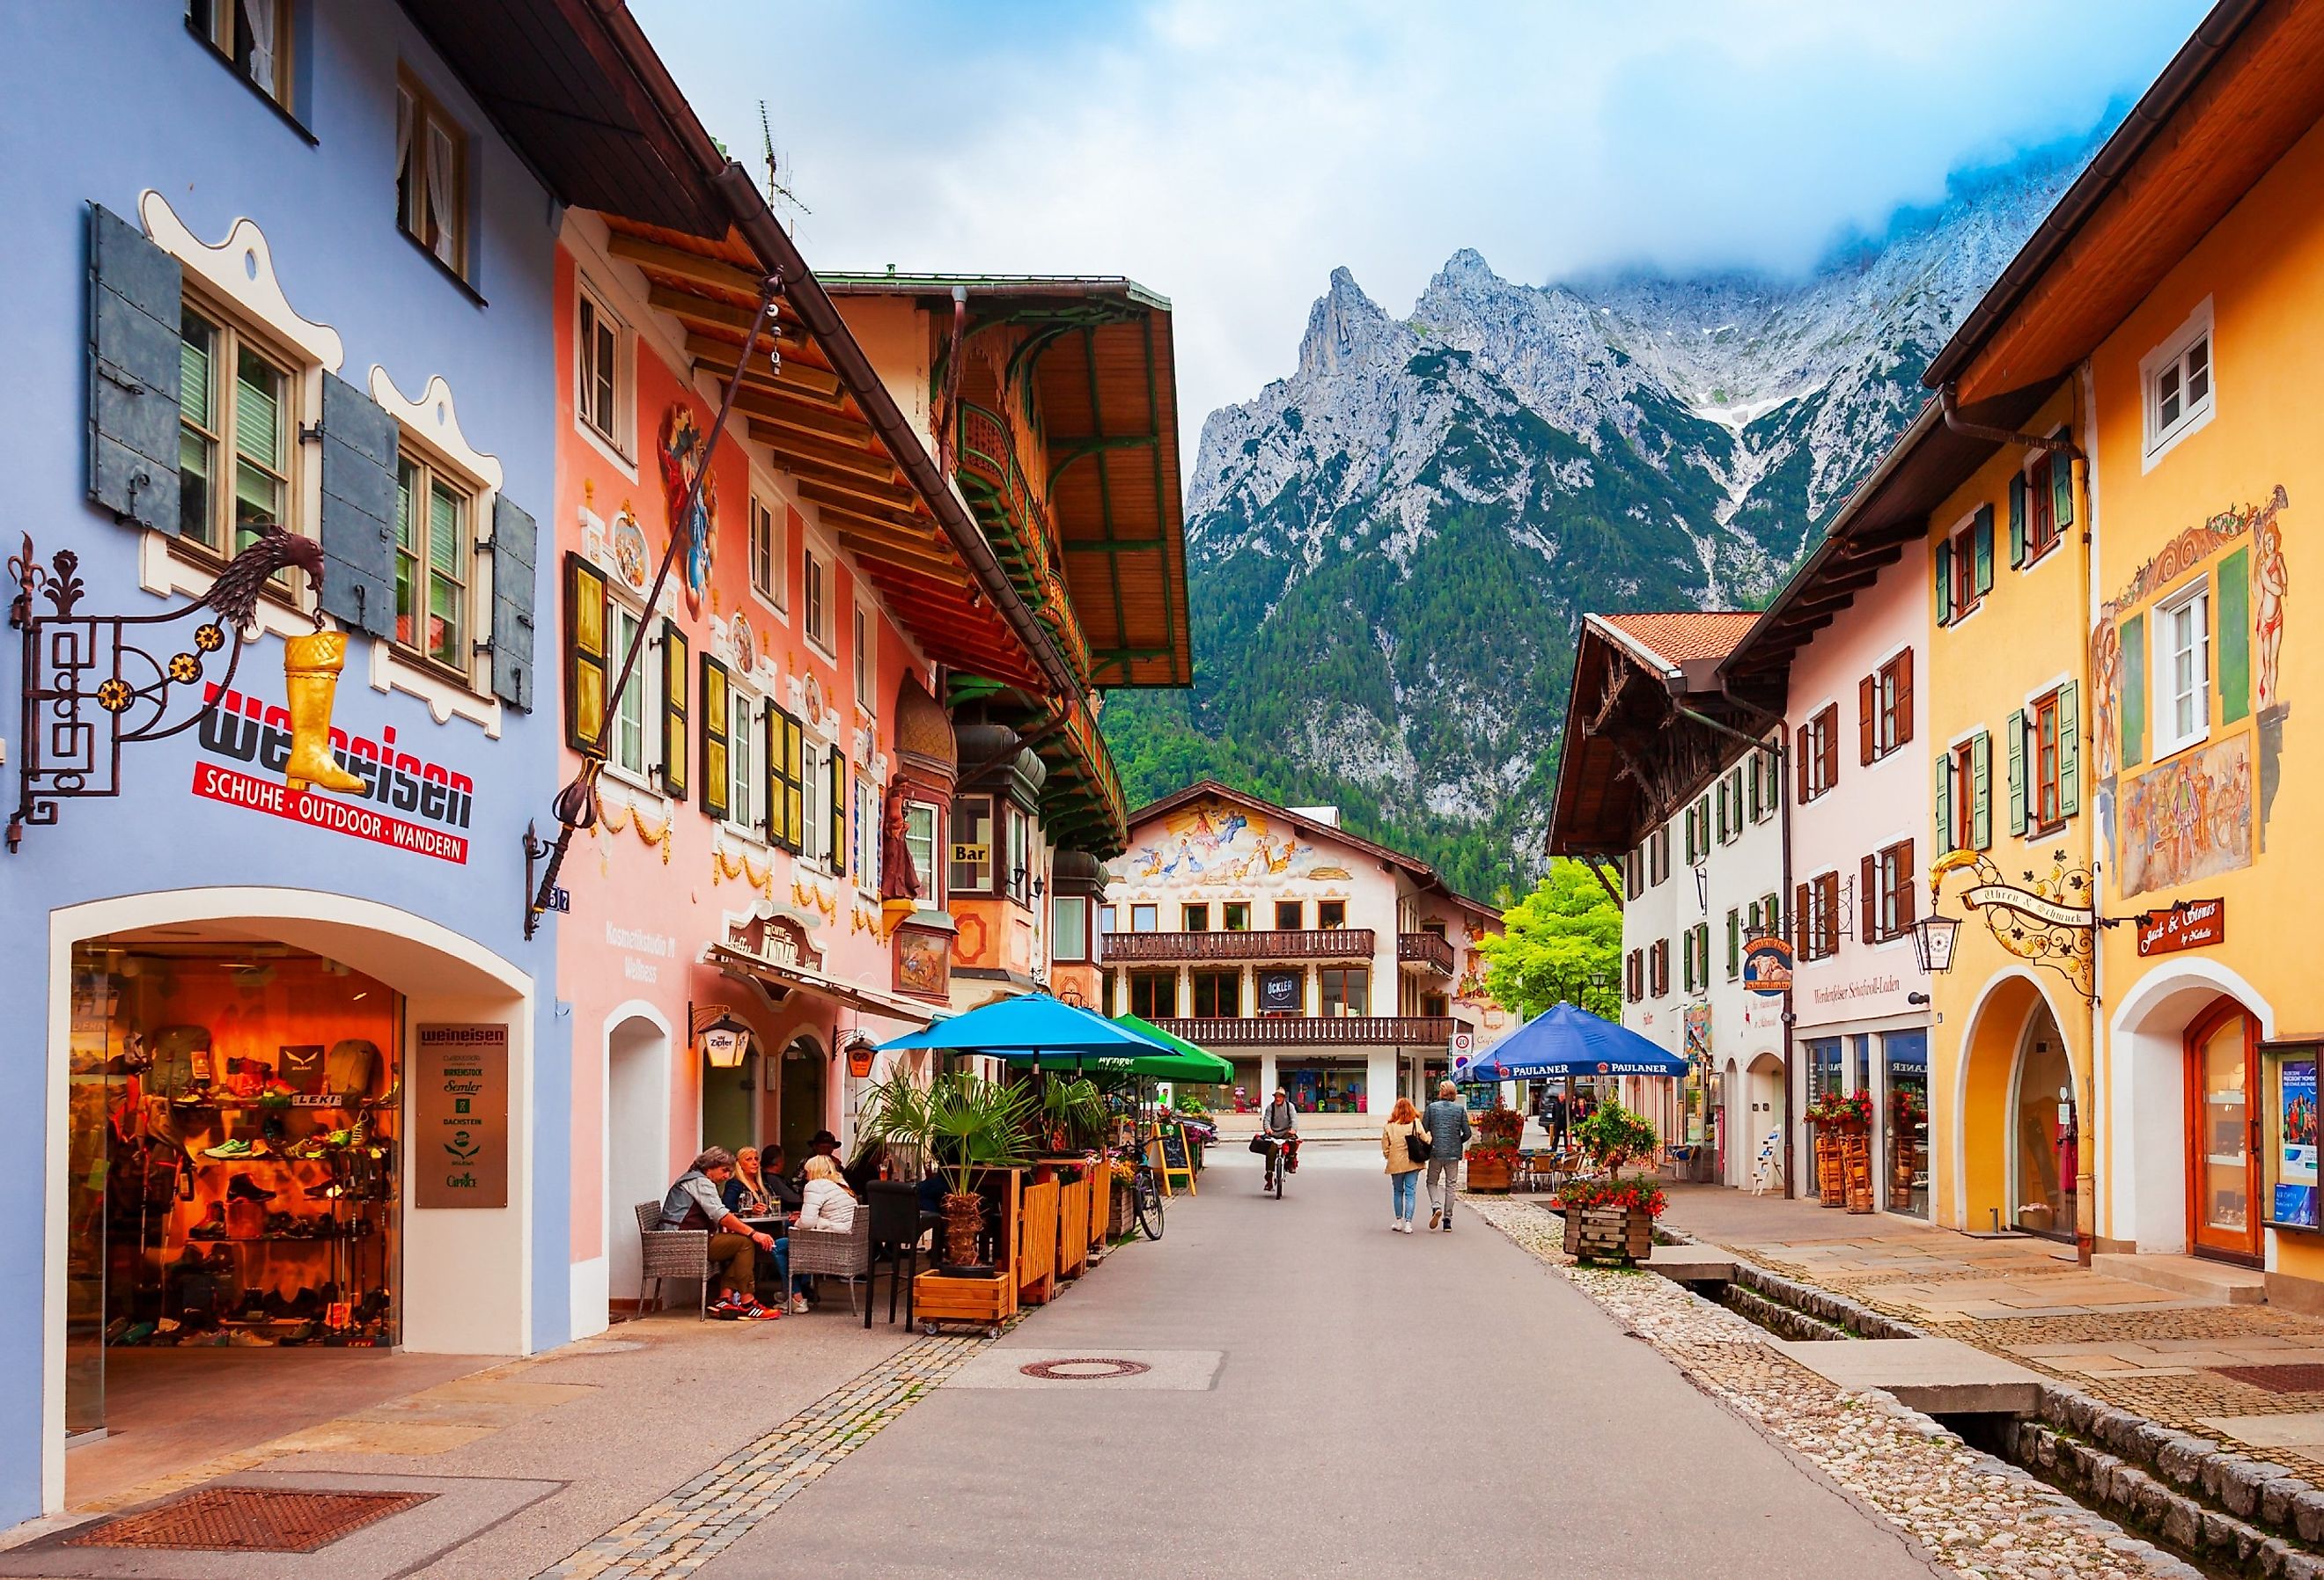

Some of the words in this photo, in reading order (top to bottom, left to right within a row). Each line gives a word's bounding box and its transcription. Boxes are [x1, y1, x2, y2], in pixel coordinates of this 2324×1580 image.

[204, 768, 284, 813] SCHUHE
[298, 796, 381, 839] OUTDOOR
[393, 822, 461, 860] WANDERN
[955, 846, 986, 861] Bar
[1984, 889, 2019, 902] Uhren
[2036, 904, 2082, 923] Schmuck
[422, 1028, 504, 1042] weineisen
[1513, 1064, 1570, 1077] PAULANER
[1612, 1063, 1667, 1073] PAULANER
